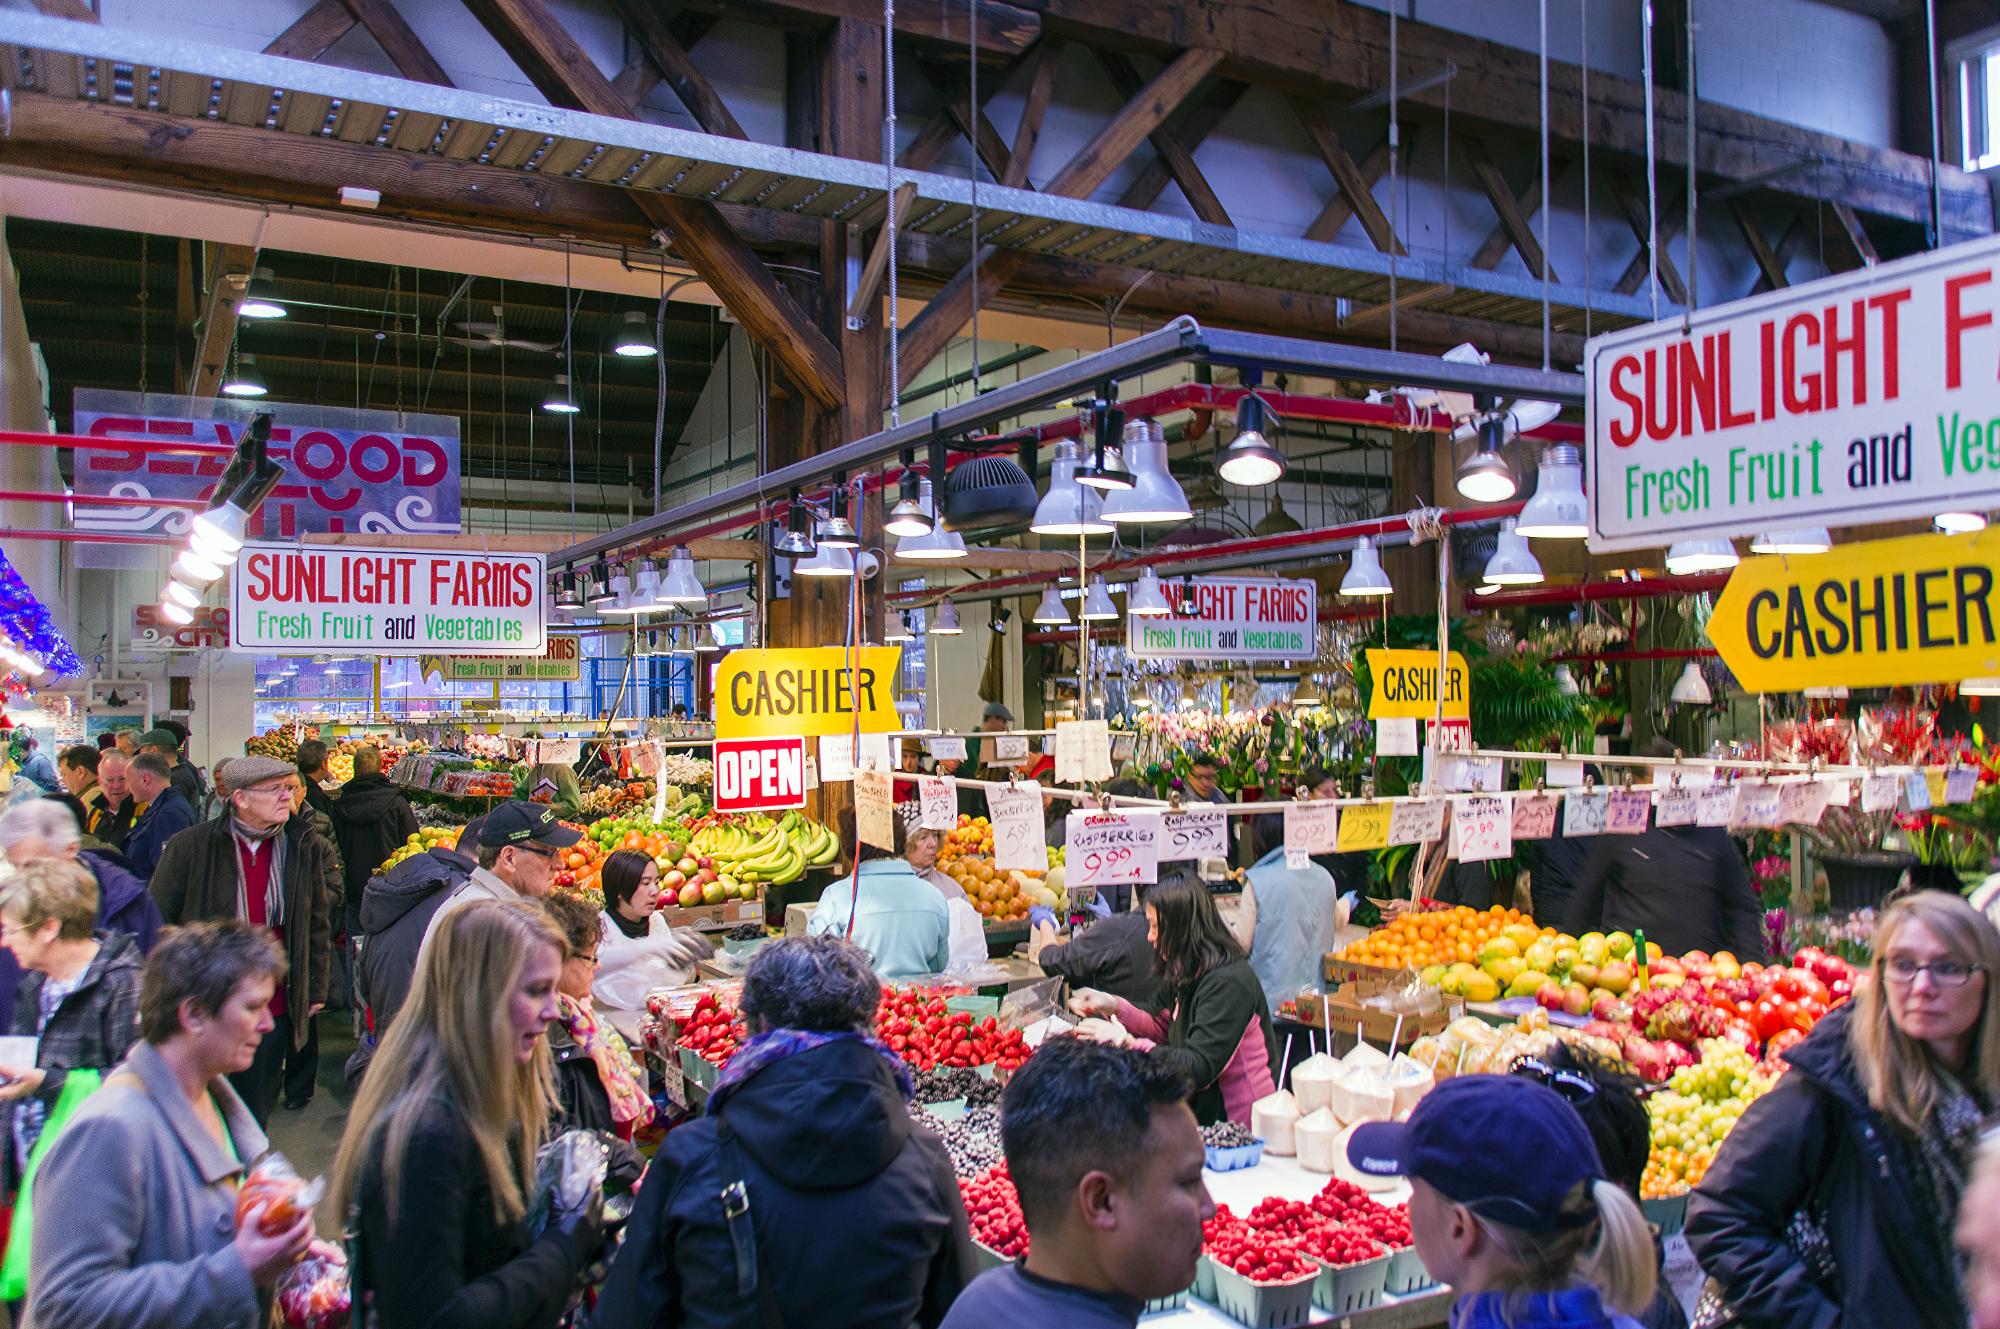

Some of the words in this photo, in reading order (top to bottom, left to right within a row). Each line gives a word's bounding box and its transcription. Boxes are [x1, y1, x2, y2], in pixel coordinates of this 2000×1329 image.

[1609, 288, 1912, 449] SUNLIGHT
[1944, 268, 2000, 391] F
[1626, 457, 1710, 520] Fresh
[1728, 438, 1824, 506] Fruit
[1848, 424, 1912, 489] and
[197, 482, 362, 537] ITY
[247, 553, 417, 605] SUNLIGHT
[430, 560, 532, 608] FARMS
[1138, 583, 1237, 622] NLIGHT
[1245, 585, 1308, 624] FARMS
[258, 611, 311, 640] Fresh
[322, 612, 374, 640] Fruit
[385, 614, 415, 640] and
[425, 614, 523, 641] Vegetables
[1746, 565, 1997, 660] CASHIER
[1143, 626, 1175, 649] Fresh
[1182, 628, 1212, 649] Fruit
[1218, 628, 1237, 649] and
[1243, 629, 1303, 650] Vegetables
[453, 662, 476, 676] Fresh
[480, 663, 503, 676] Fruit
[507, 664, 522, 676] and
[525, 663, 570, 676] Veetables
[731, 668, 876, 717] CASHIER
[718, 747, 801, 800] OPEN
[1073, 829, 1154, 847] RASPBERRIES
[1085, 815, 1127, 826] ORGANIC
